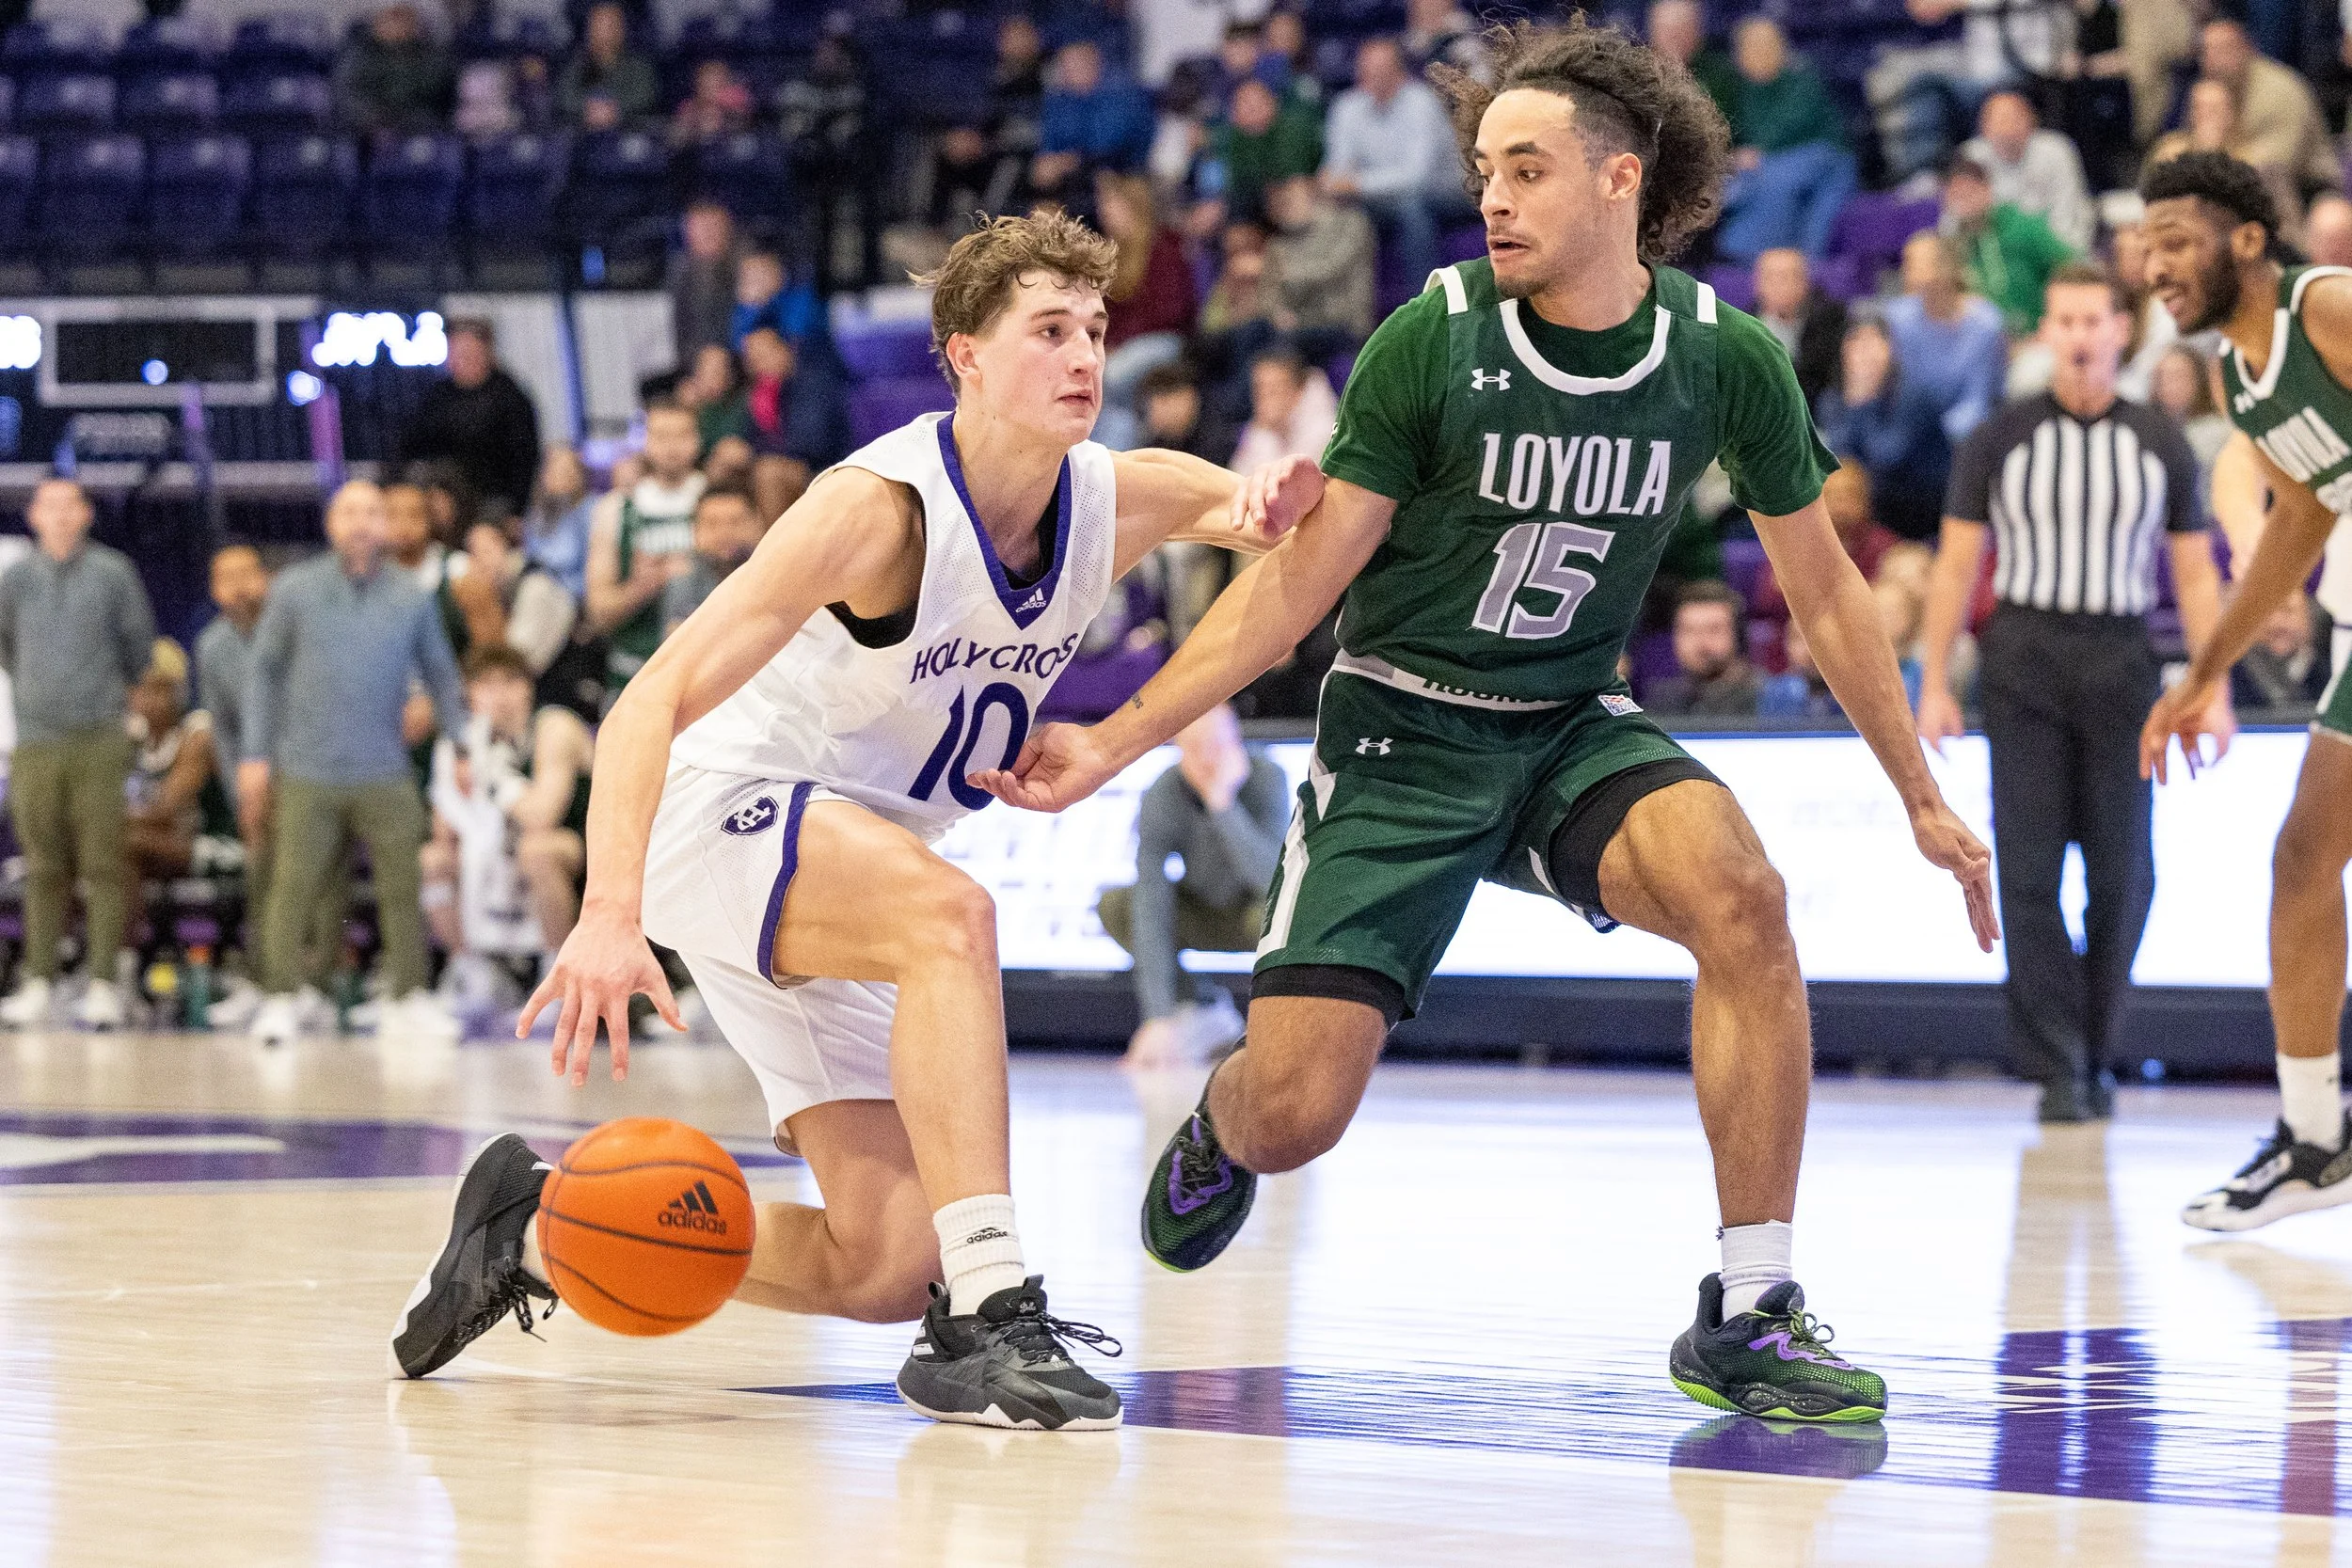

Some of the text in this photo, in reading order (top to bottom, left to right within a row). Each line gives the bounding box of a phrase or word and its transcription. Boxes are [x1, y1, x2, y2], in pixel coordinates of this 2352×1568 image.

[1478, 432, 1673, 516] LOYOLA
[1470, 520, 1617, 641] 15
[907, 683, 1029, 811] 10
[658, 1210, 727, 1236] adidas
[966, 1230, 1009, 1244] adidas
